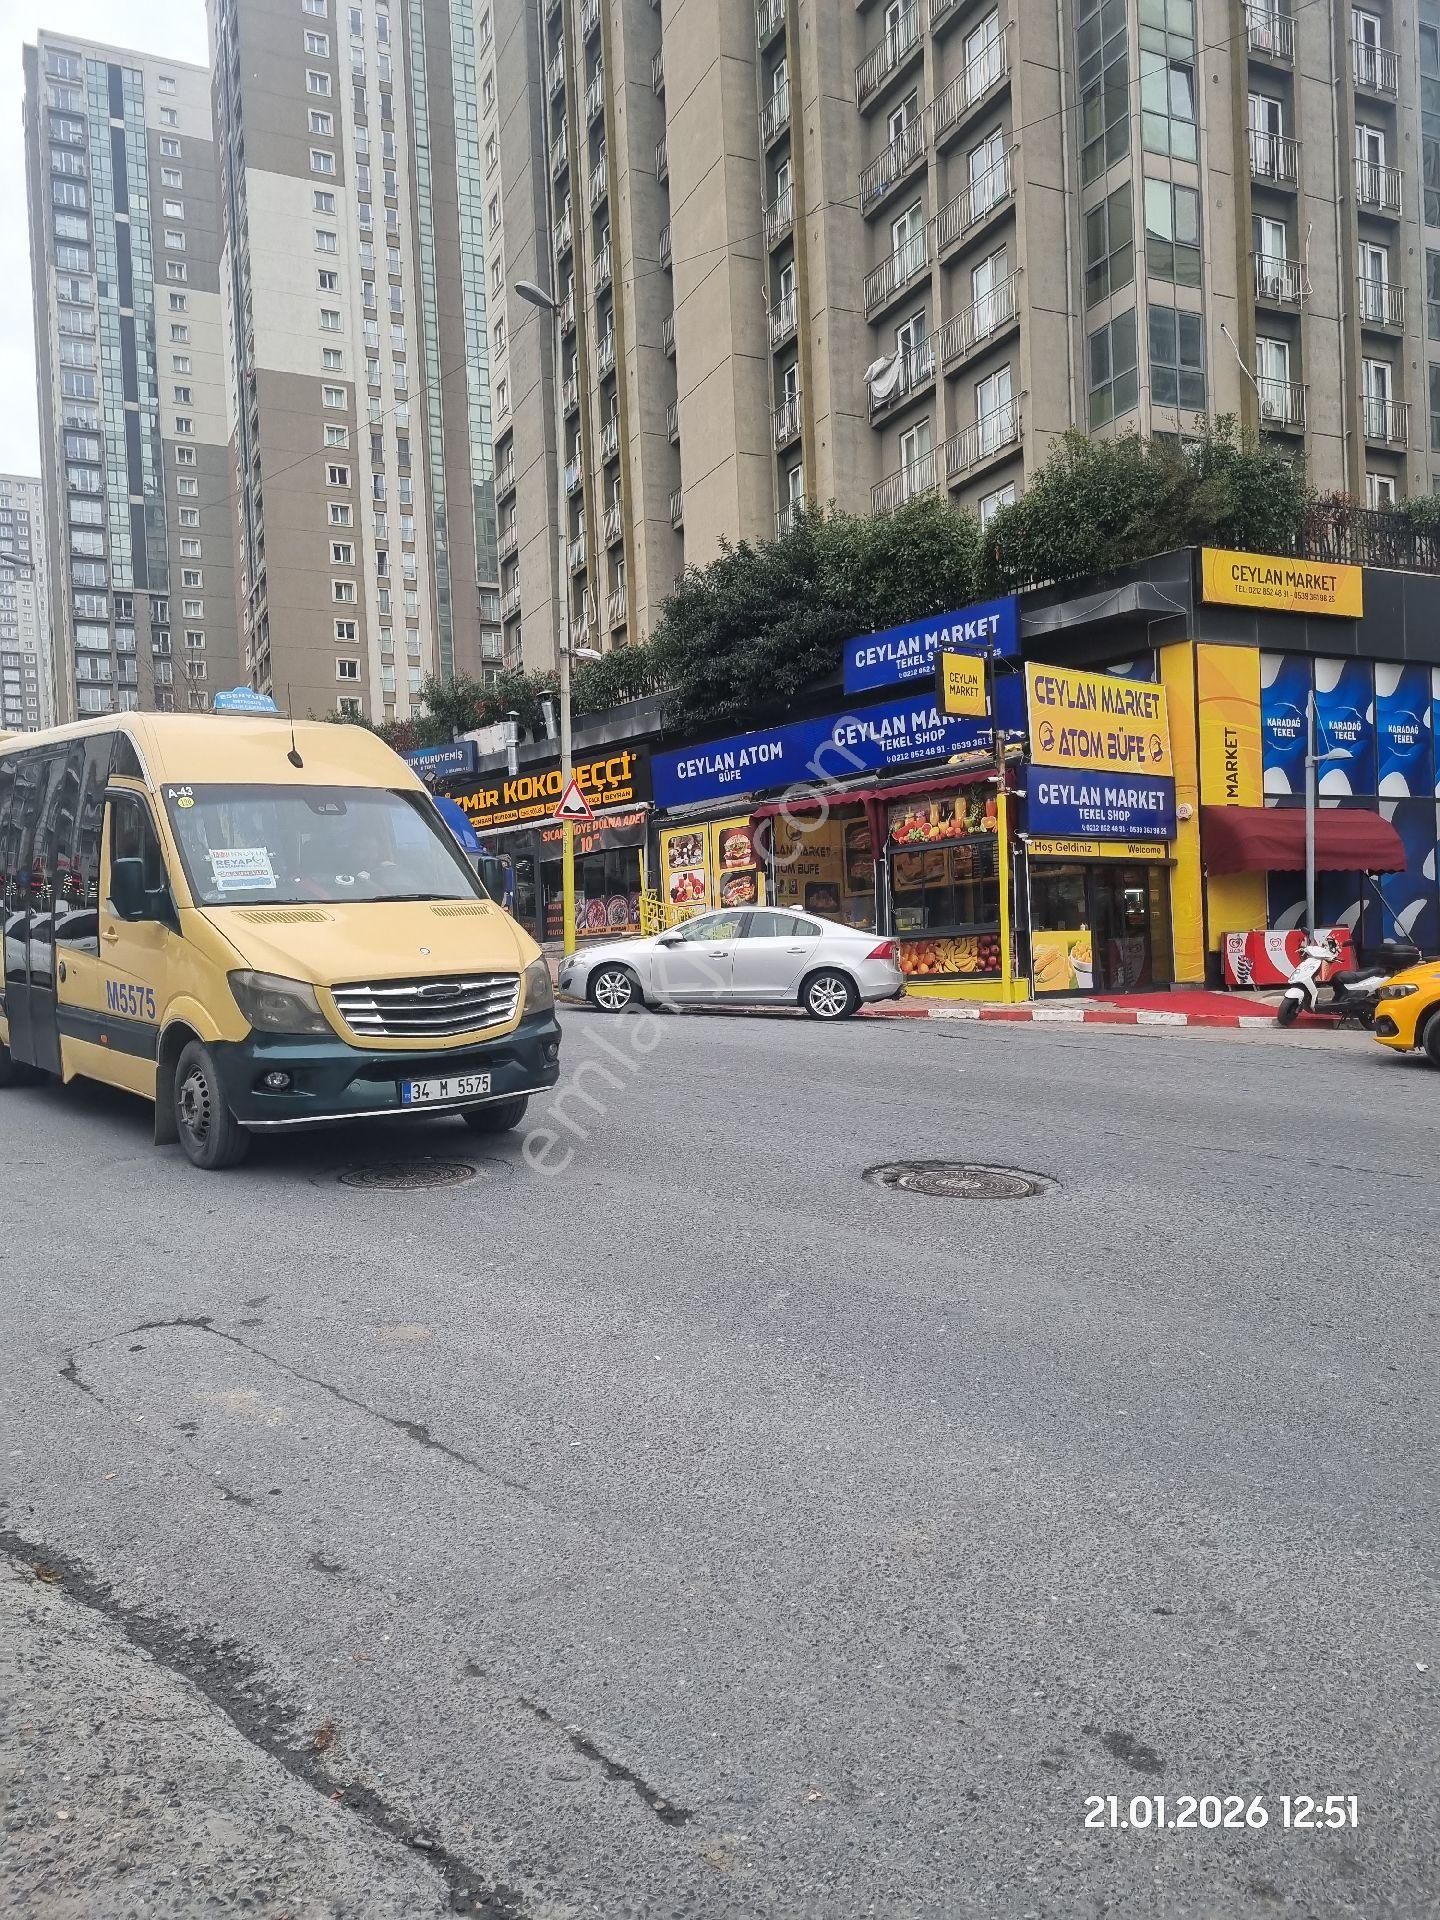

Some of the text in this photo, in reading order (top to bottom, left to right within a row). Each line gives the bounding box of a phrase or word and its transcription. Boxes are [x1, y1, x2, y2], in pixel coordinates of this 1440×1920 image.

[1232, 564, 1337, 592] CEYLAN MARKET
[1248, 586, 1262, 594] 0212
[1262, 588, 1274, 596] 852
[1274, 590, 1282, 598] 48
[1329, 595, 1336, 603] 25
[855, 614, 1000, 668] CEYLAN MARKET
[896, 654, 926, 670] TEKEL
[950, 672, 978, 684] CEYLAN
[950, 684, 979, 697] MARKET
[1034, 675, 1160, 720] CEYLAN MARKET
[1266, 716, 1301, 728] KARADAĞ
[1328, 720, 1362, 731] KARADAĞ
[1388, 723, 1419, 735] KARADAĞ
[834, 714, 906, 747] CEYLAN
[1272, 728, 1296, 738] TEKEL
[1334, 730, 1356, 741] TEKEL
[880, 729, 946, 752] TEKEL SHOP
[1058, 726, 1146, 762] ATOM BÜFE
[1393, 734, 1414, 744] TEKEL
[420, 748, 463, 765] KURUYEMİŞ
[892, 752, 909, 762] 0212
[910, 750, 924, 760] 852
[926, 748, 935, 757] 48
[936, 745, 946, 755] 91
[952, 742, 971, 752] 0539
[972, 738, 986, 748] 361
[676, 742, 783, 779] CEYLAN ATOM
[1224, 726, 1239, 798] MARKET
[448, 750, 632, 812] ZMİR KOKOEÇÇİ
[718, 770, 742, 783] BÜFE
[168, 786, 194, 798] A-43
[604, 790, 631, 801] BEYRAN
[1038, 783, 1165, 811] CEYLAN MARKET
[622, 812, 646, 826] ADET
[1078, 808, 1131, 822] TEKEL SHOP
[1034, 841, 1161, 854] Hoş Geldiniz Welcome
[106, 980, 156, 1020] M5575
[412, 1083, 430, 1099] 34
[440, 1080, 448, 1096] M
[458, 1076, 489, 1094] 5575
